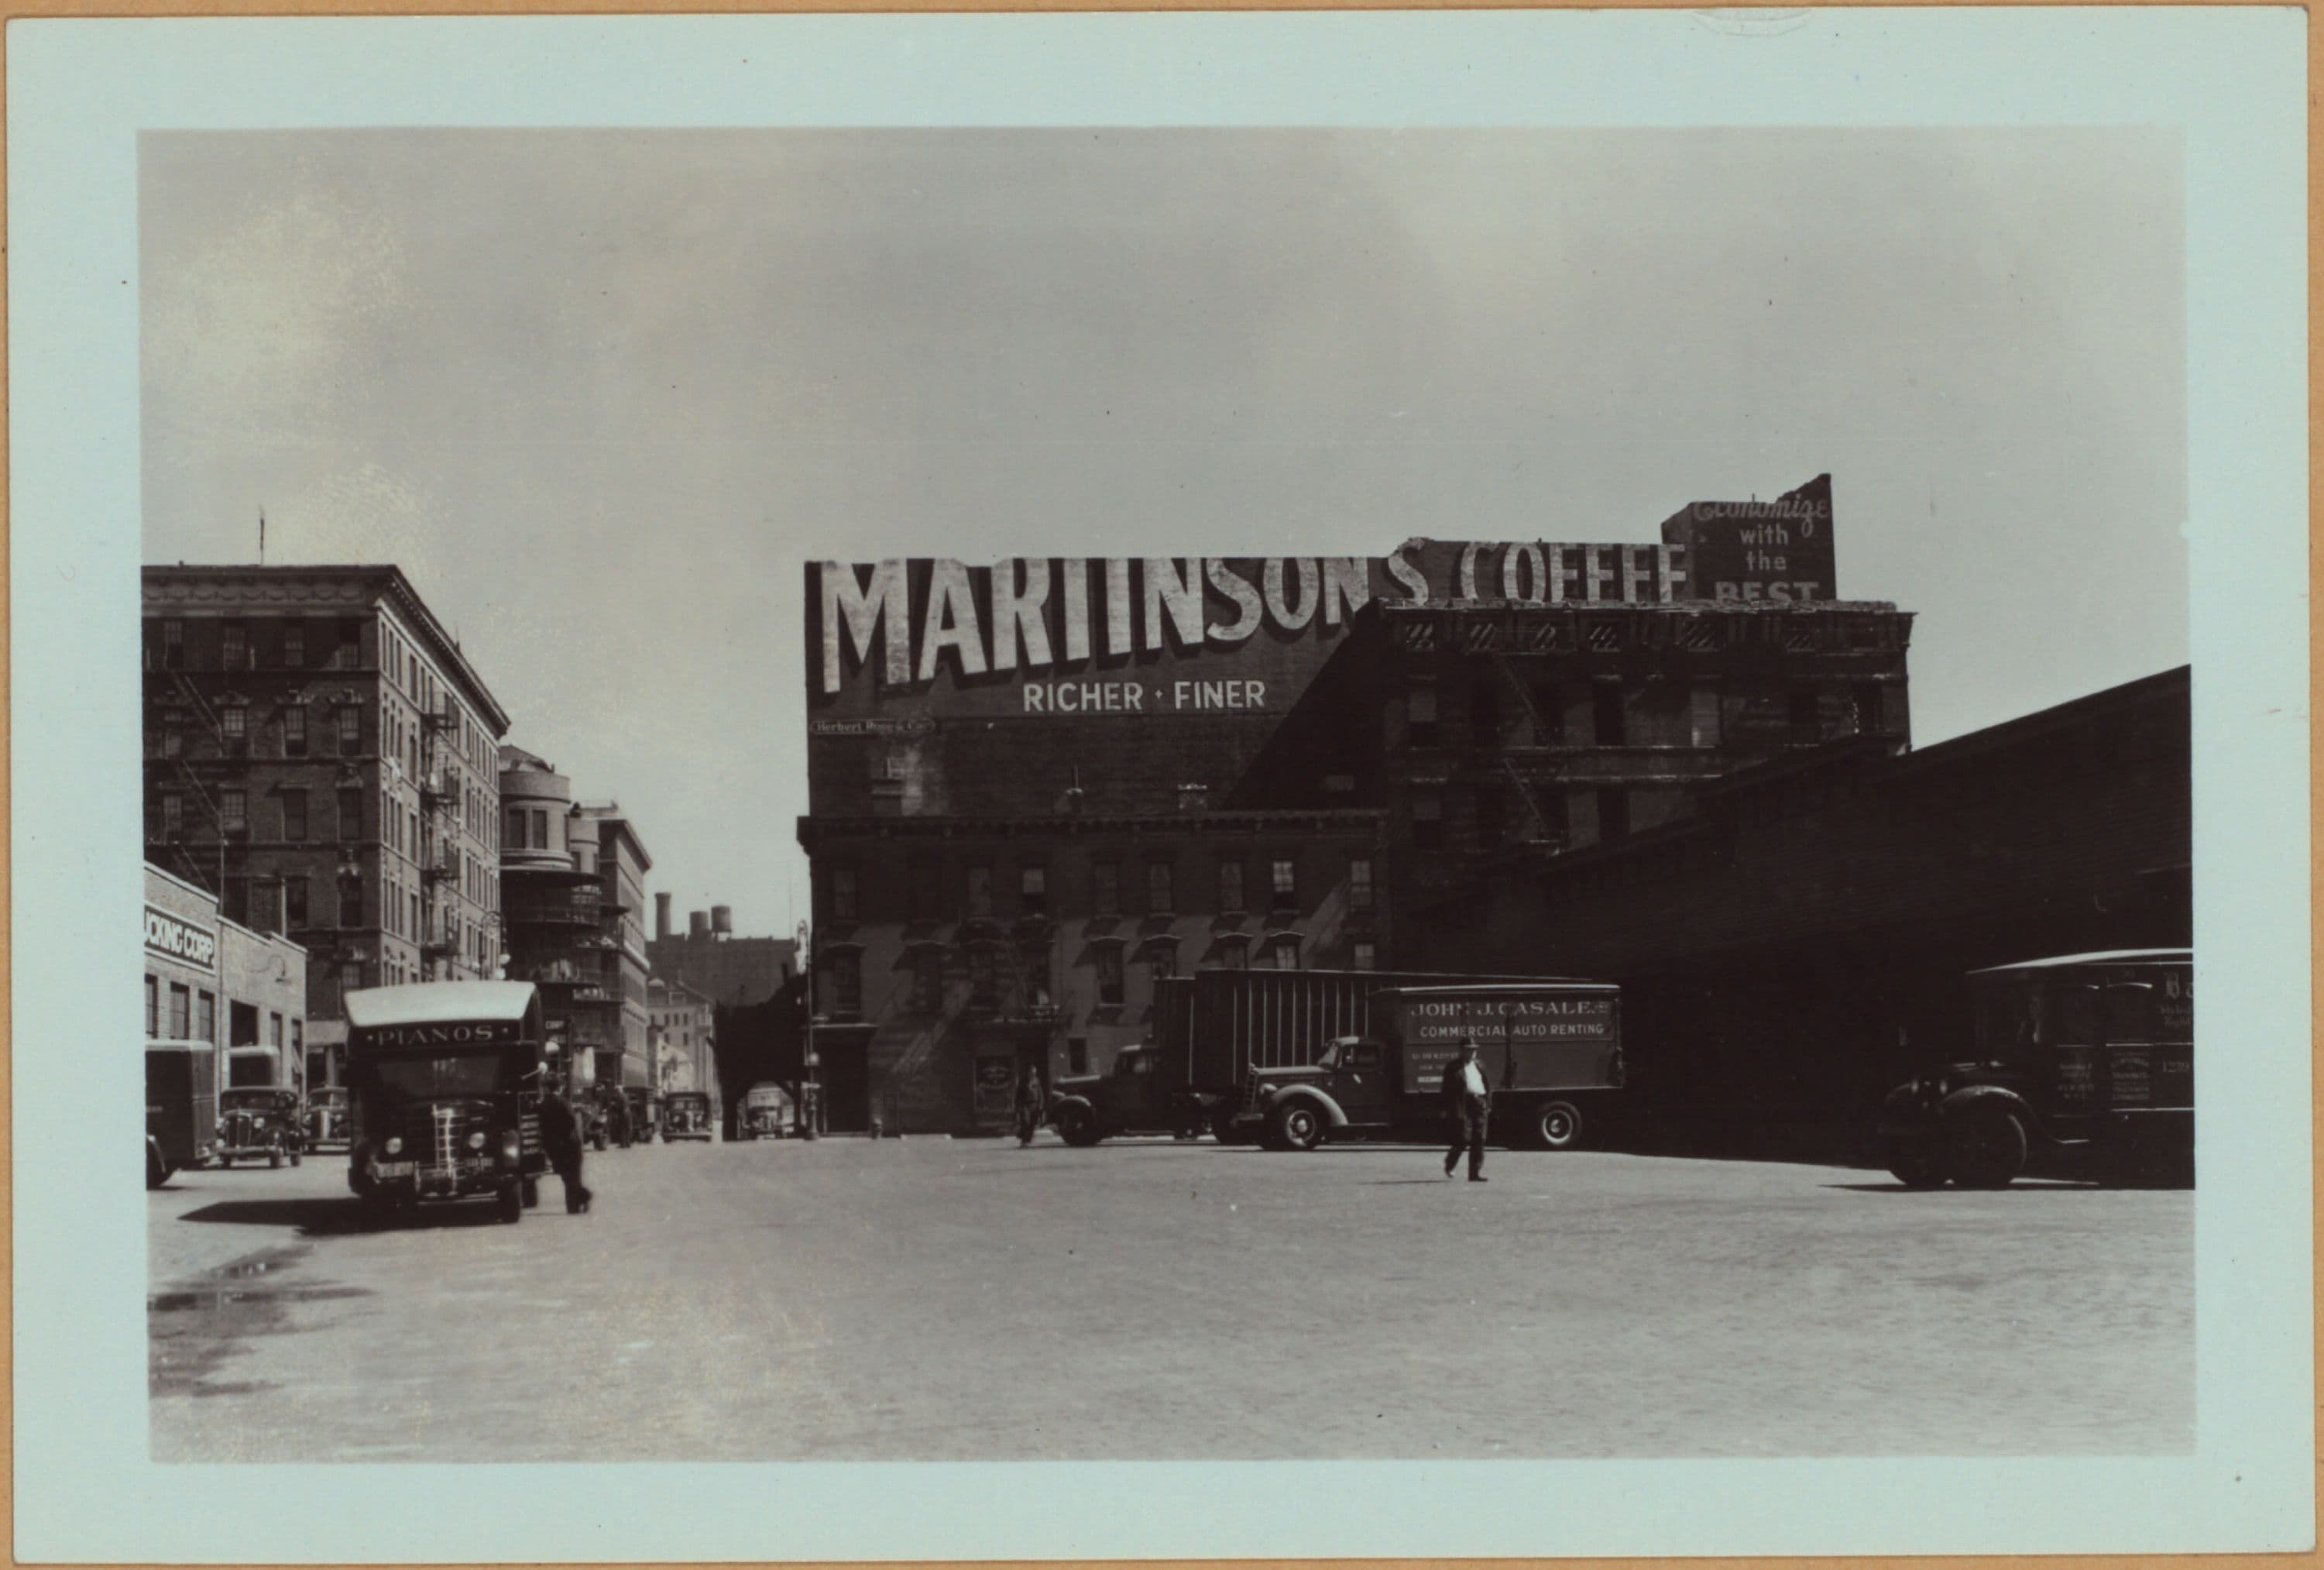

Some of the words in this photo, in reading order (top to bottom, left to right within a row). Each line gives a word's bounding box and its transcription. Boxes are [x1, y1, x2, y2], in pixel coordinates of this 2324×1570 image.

[1739, 522, 1789, 545] with
[1745, 549, 1787, 571] the
[1714, 581, 1819, 605] BEST
[1023, 682, 1144, 713] RICHER
[1174, 680, 1267, 709] FINER
[377, 1024, 493, 1045] PIANOS
[1419, 1025, 1507, 1038] COMMERCIAL
[1512, 1023, 1546, 1036] AUTO
[1550, 1022, 1605, 1036] RENTING
